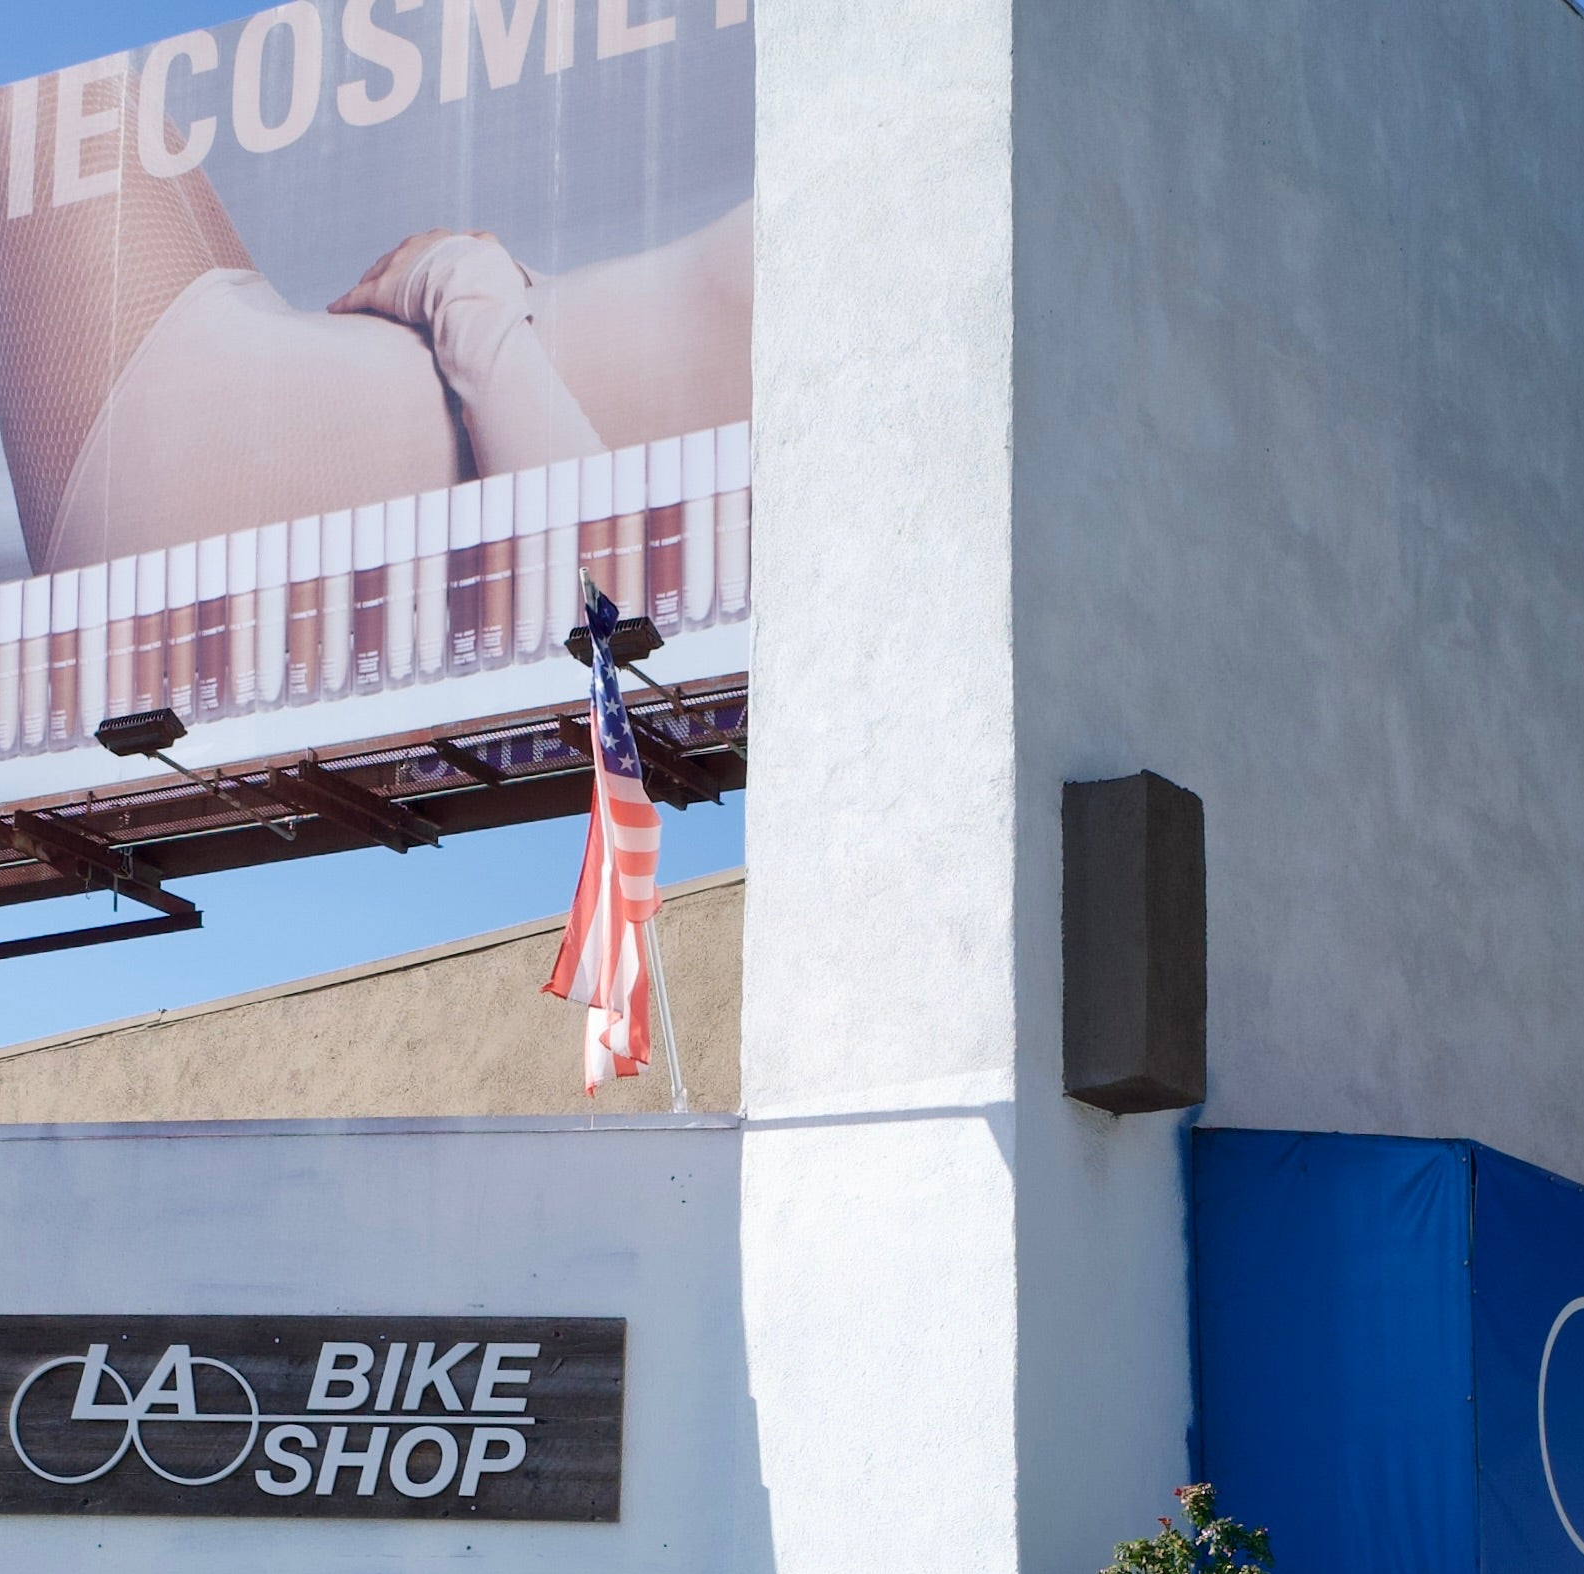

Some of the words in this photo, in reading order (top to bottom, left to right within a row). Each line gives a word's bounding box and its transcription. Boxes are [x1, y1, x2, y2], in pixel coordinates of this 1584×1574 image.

[71, 1344, 199, 1420] LA
[307, 1341, 542, 1412] BIKE
[255, 1424, 527, 1498] SHOP
